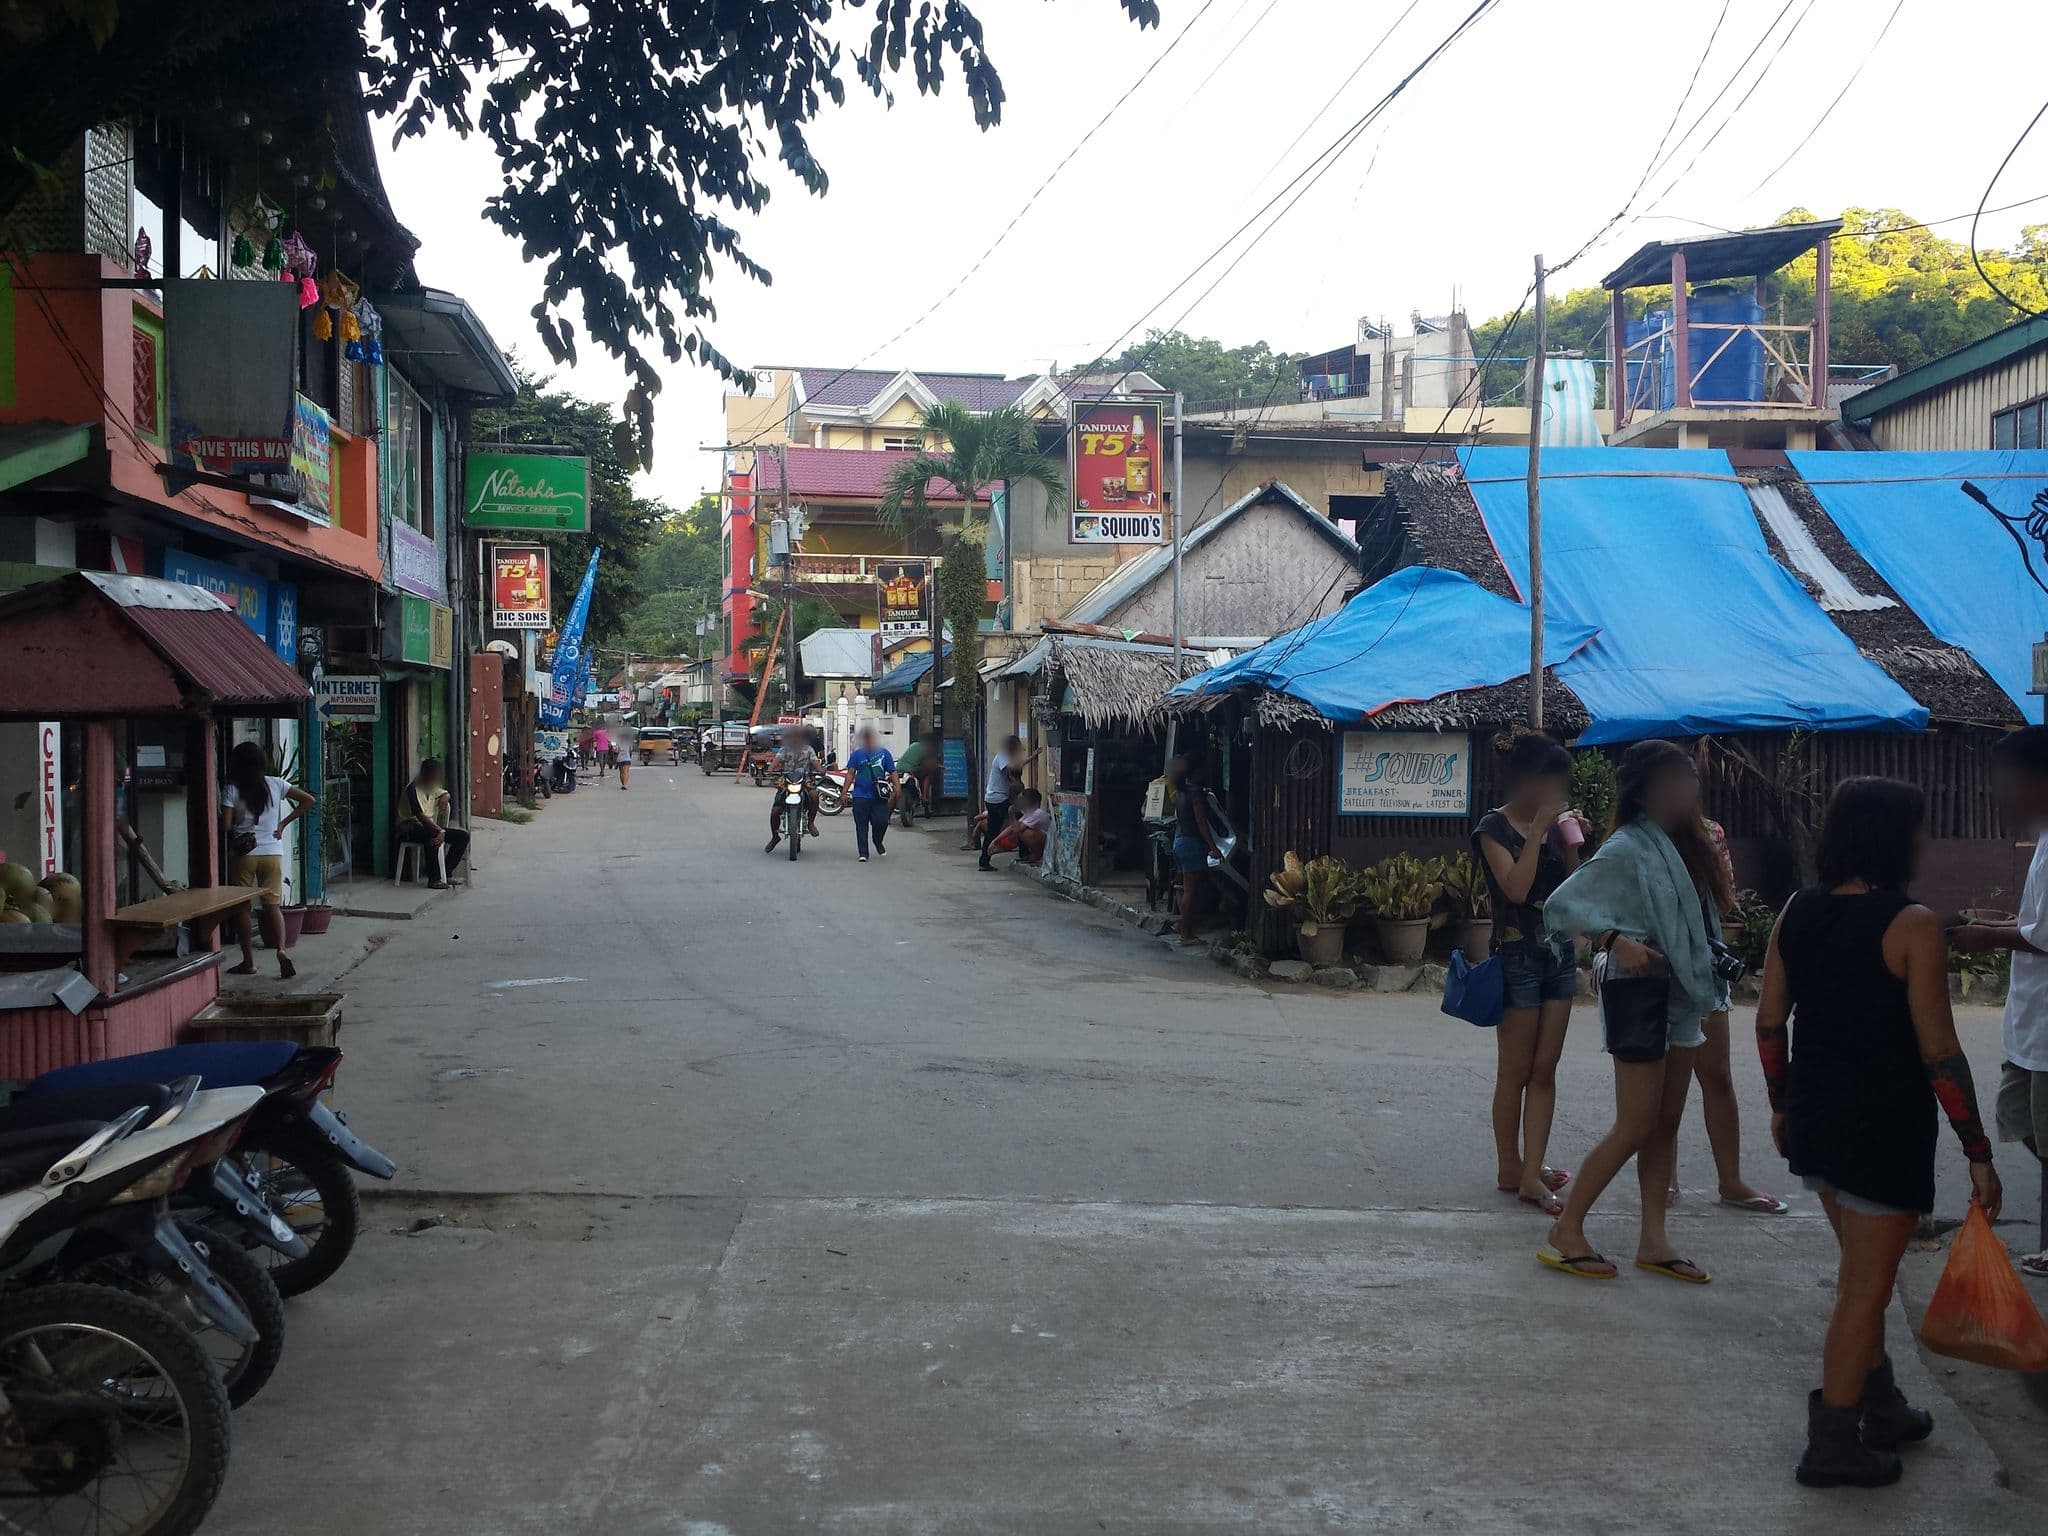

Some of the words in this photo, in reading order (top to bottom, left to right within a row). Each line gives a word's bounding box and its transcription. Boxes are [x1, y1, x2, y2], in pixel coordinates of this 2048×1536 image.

[1077, 423, 1130, 433] TANDUAY
[194, 440, 226, 457] DIVE
[228, 440, 260, 458] THIS
[263, 441, 292, 458] WAY
[1080, 433, 1126, 456] T5
[470, 468, 584, 513] Natasha
[1101, 515, 1161, 538] SQUIDO'S
[498, 564, 526, 578] T5
[496, 612, 516, 622] RIC
[517, 612, 547, 622] SONS
[888, 609, 920, 617] TANDUAY
[316, 680, 379, 695] INTERNET
[330, 696, 344, 704] MP3
[345, 696, 378, 704] DOWNLOAD
[1345, 787, 1397, 797] BREAKFAST
[1431, 789, 1462, 798] DINNER
[1343, 798, 1375, 808] SATELLITE
[1379, 799, 1411, 808] TELEVISION
[1426, 800, 1450, 809] LATEST
